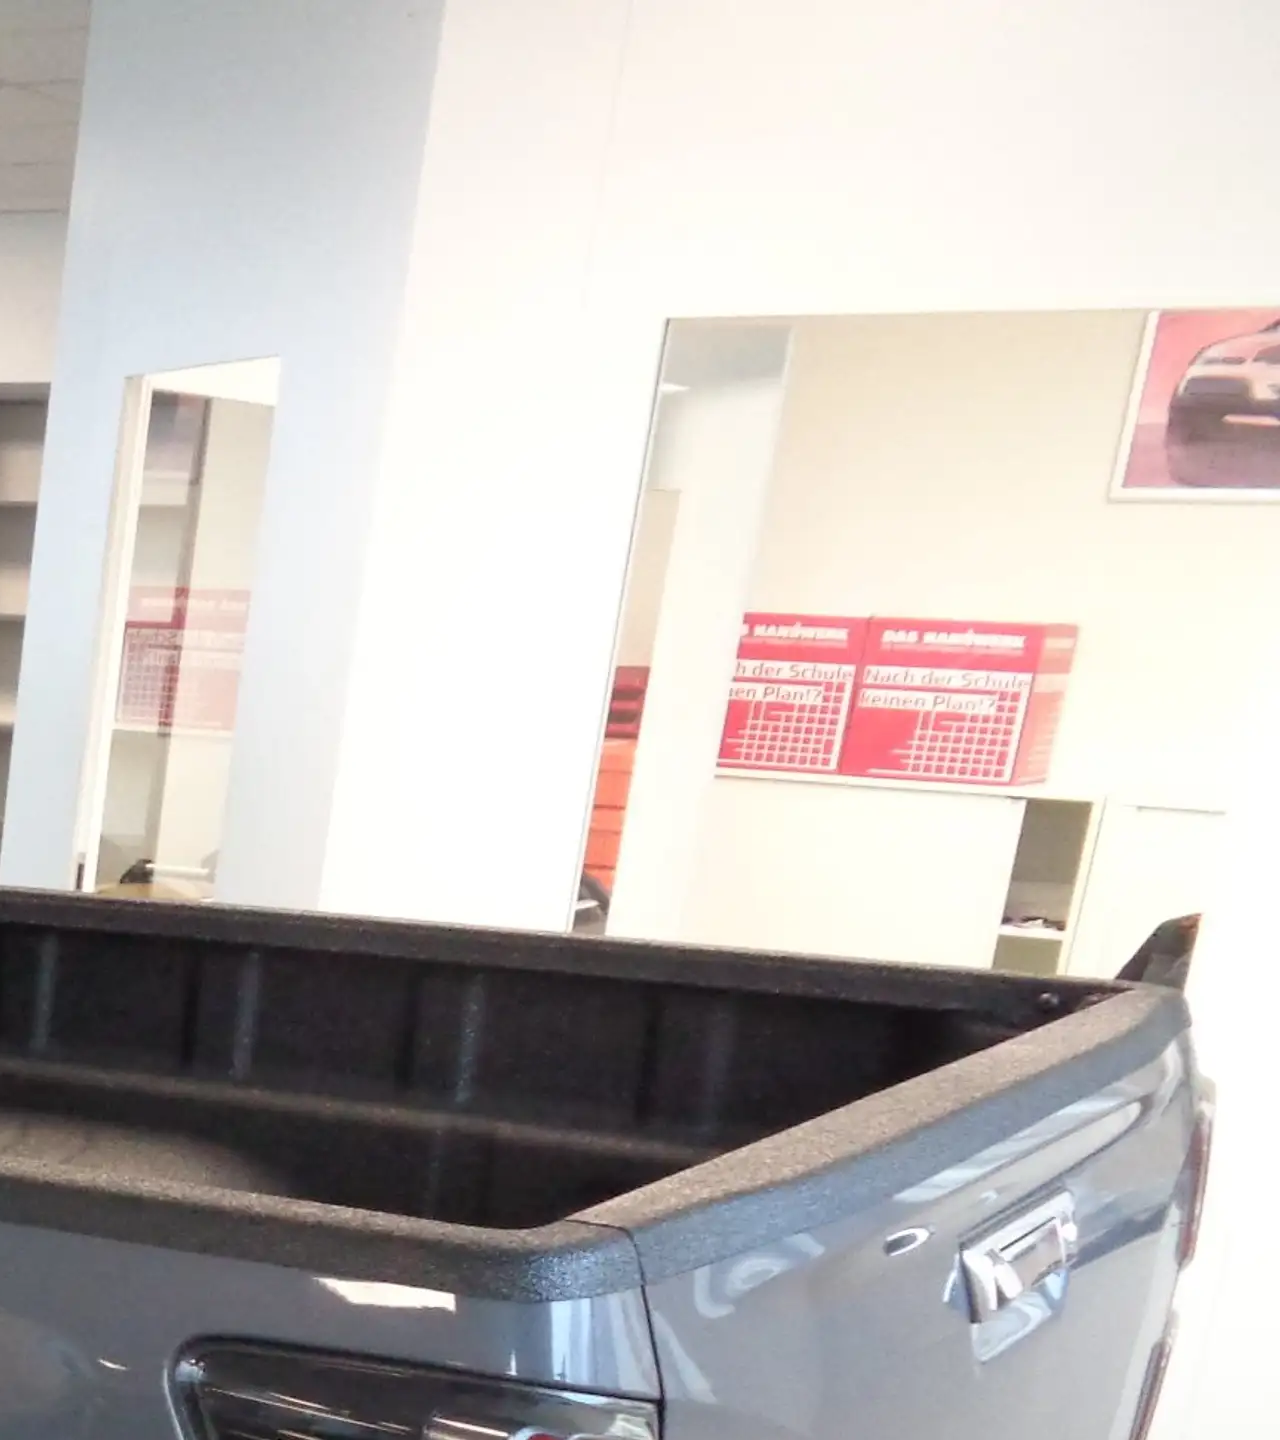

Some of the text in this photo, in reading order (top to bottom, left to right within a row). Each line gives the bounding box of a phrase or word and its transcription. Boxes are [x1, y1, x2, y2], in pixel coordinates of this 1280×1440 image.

[751, 663, 782, 678] der
[789, 664, 854, 681] Schule
[864, 667, 1031, 690] Nach der Schule
[762, 685, 824, 702] Plan!?
[860, 690, 998, 713] keinen Plan!?
